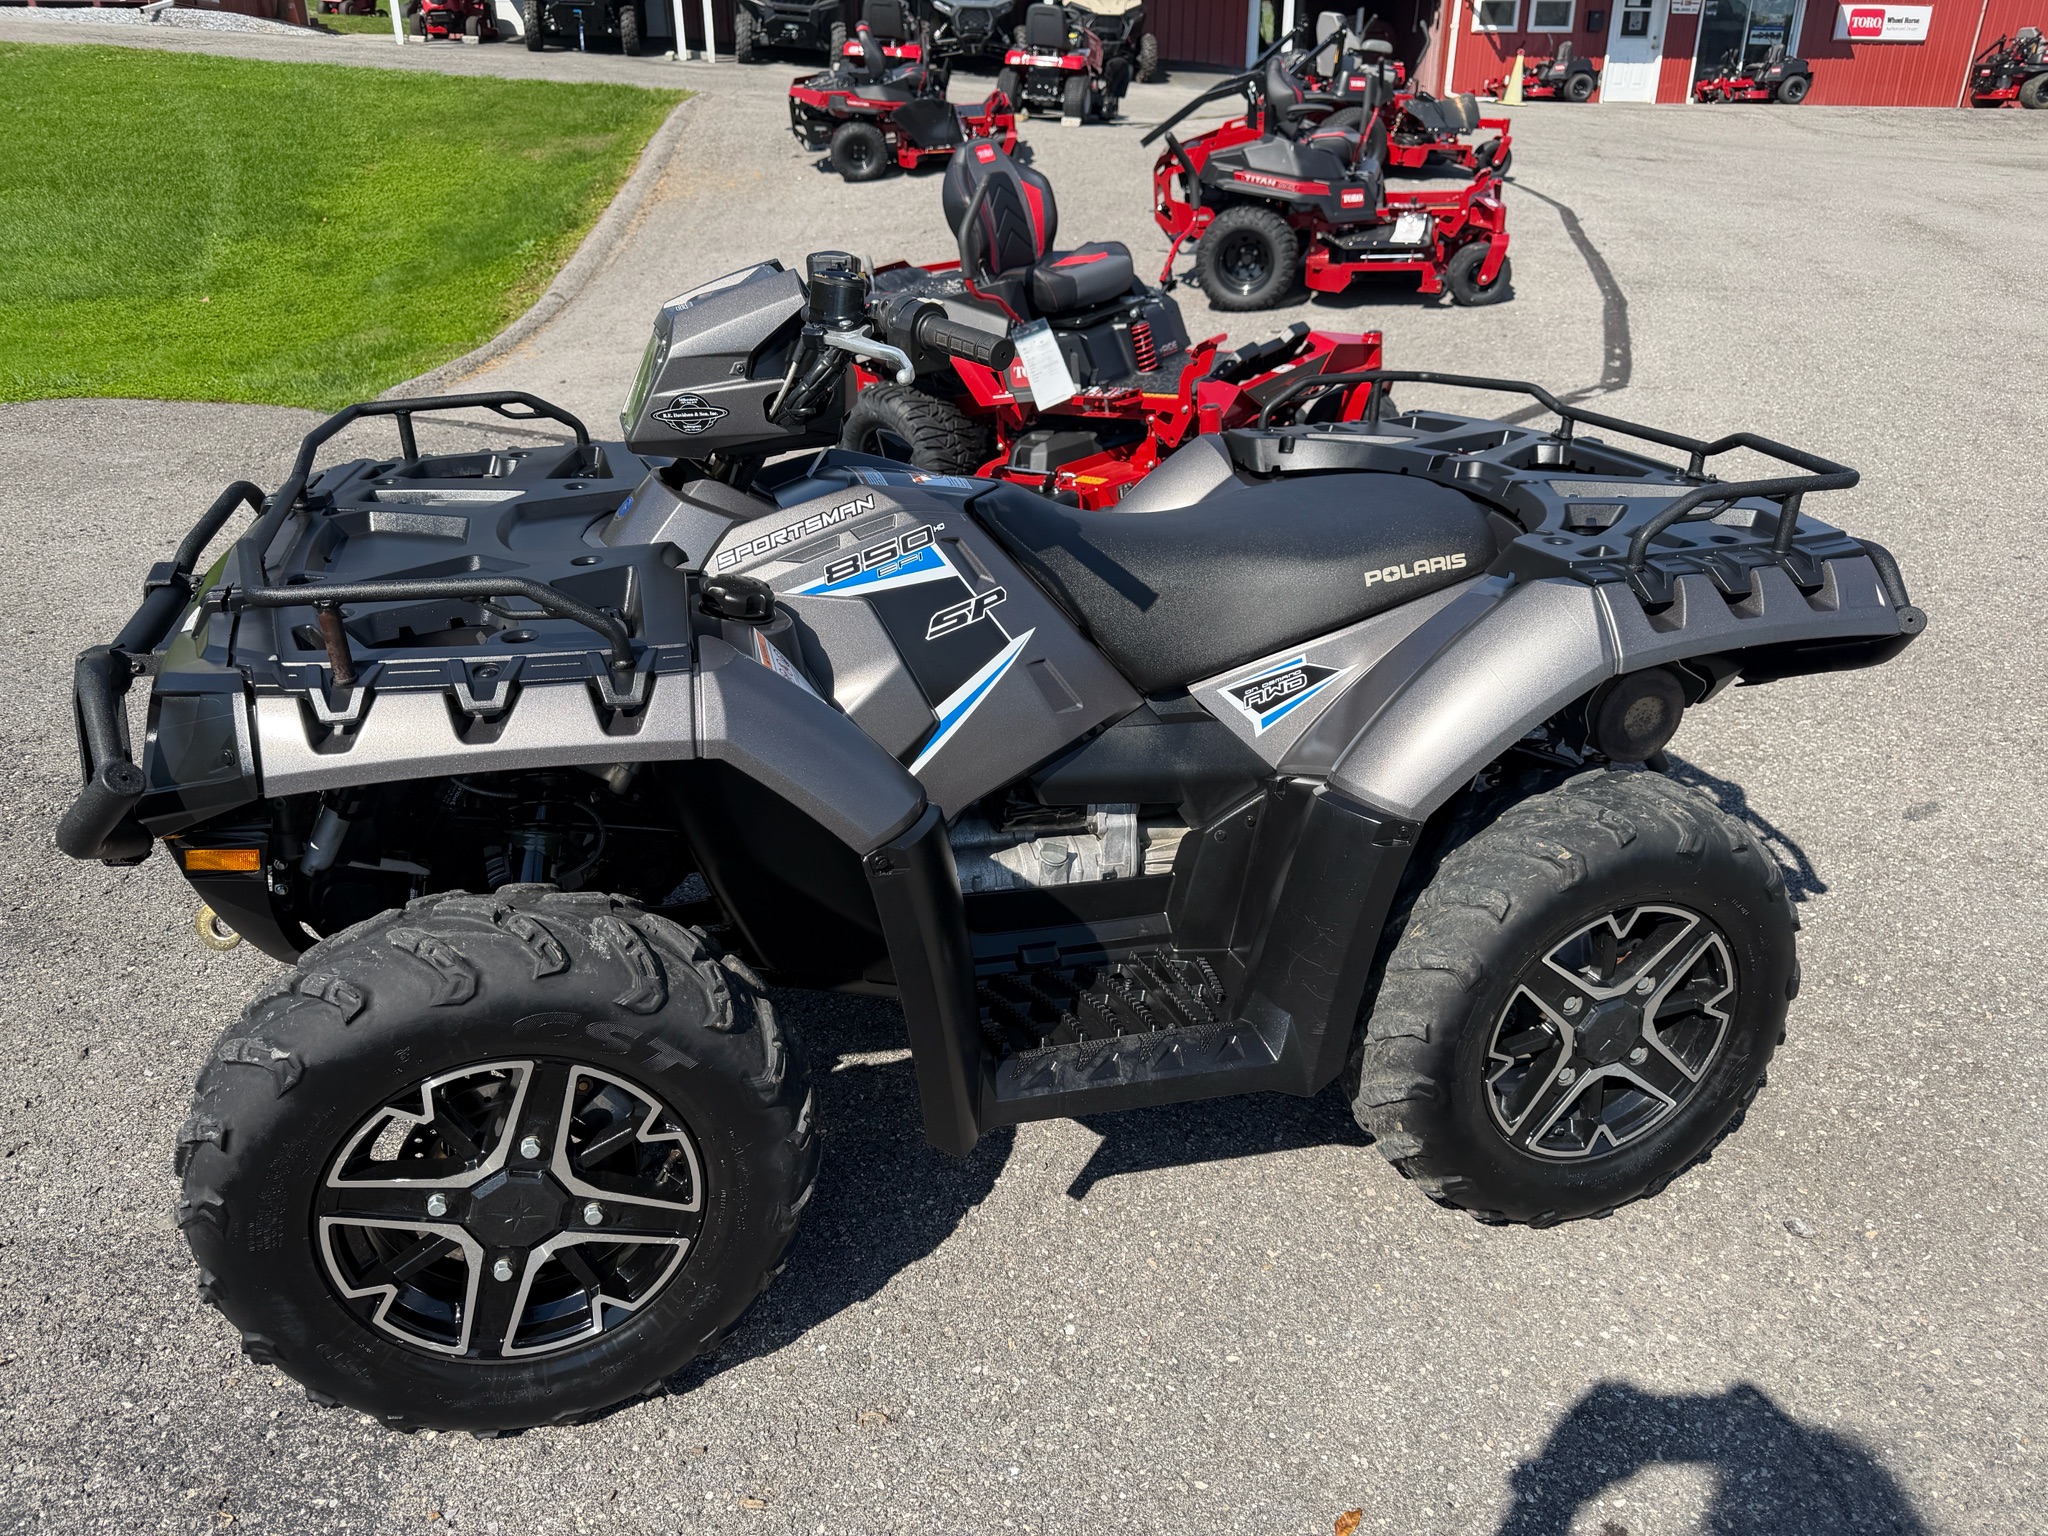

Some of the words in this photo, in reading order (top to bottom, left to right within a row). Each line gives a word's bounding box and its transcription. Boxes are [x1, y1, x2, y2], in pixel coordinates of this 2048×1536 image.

[1852, 16, 1883, 29] TORO
[1244, 174, 1277, 188] TITAN
[1341, 193, 1365, 204] TORO
[716, 493, 876, 571] SPORTSMAN
[823, 524, 936, 587] 850
[877, 551, 924, 579] EFI
[1363, 553, 1467, 588] POLARIS
[925, 585, 1008, 641] SP
[1243, 673, 1308, 711] AWD
[511, 1010, 700, 1075] CST
